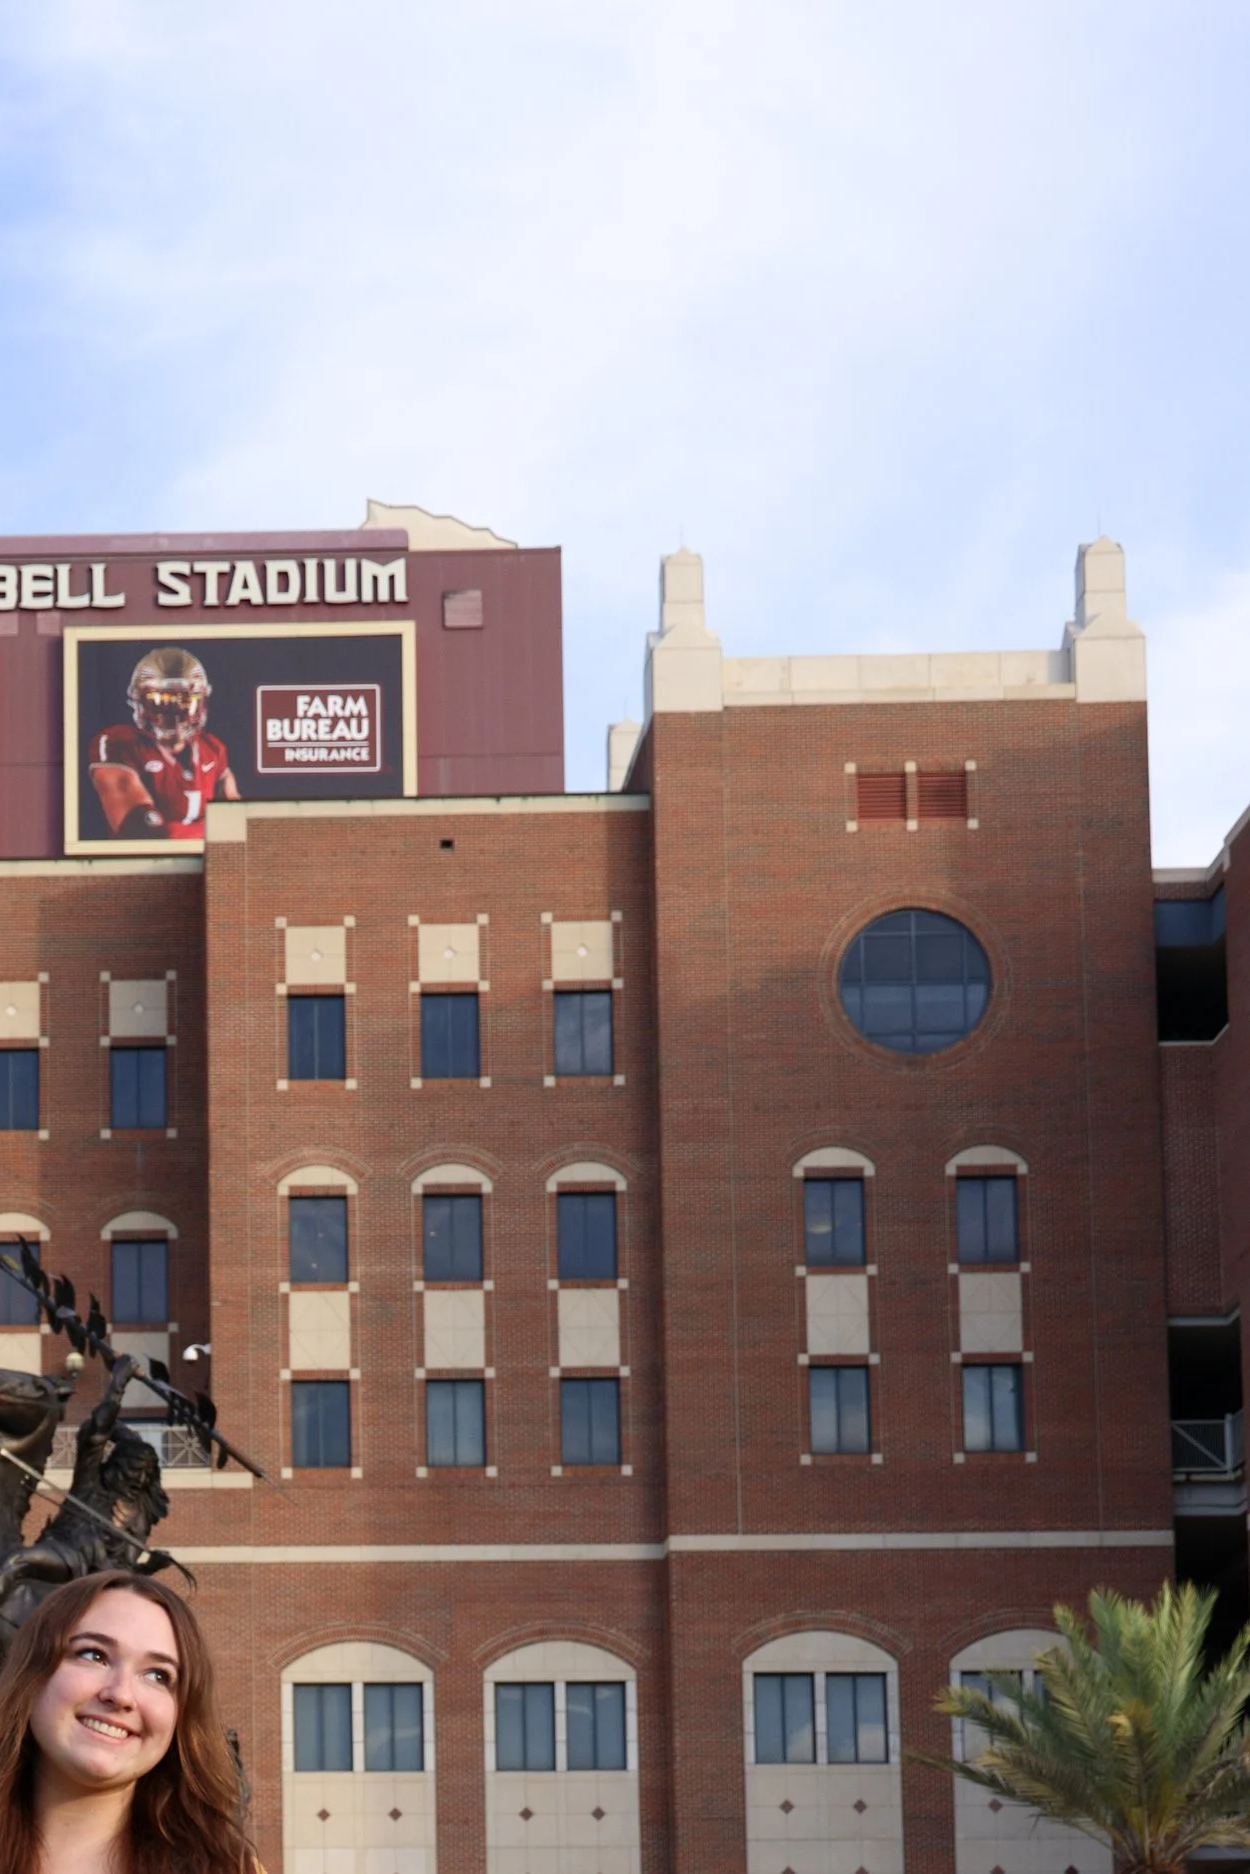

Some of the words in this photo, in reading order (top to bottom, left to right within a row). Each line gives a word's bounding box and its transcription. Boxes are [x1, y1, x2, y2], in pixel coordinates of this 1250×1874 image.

[156, 558, 408, 607] STADIUM
[297, 694, 368, 718] FARM
[266, 718, 369, 741] BUREAU
[285, 747, 369, 762] INSURANCE
[183, 790, 202, 825] 1
